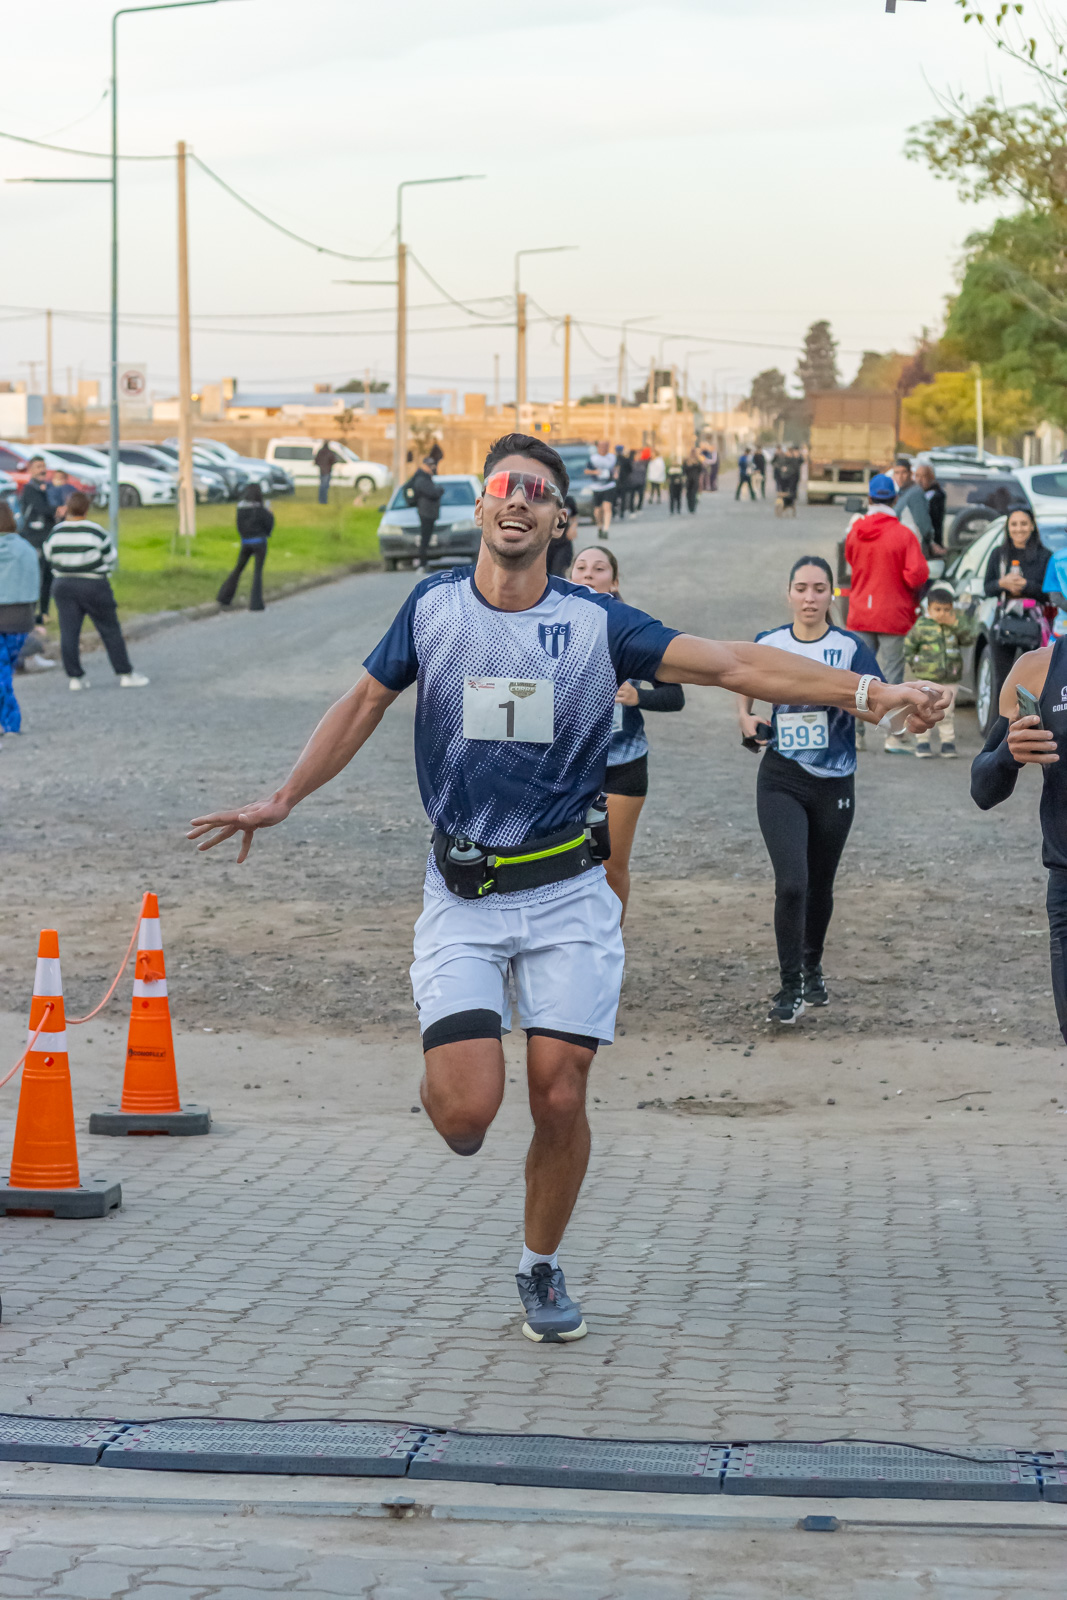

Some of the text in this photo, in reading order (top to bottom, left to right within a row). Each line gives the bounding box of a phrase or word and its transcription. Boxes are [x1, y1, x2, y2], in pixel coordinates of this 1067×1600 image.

[544, 626, 566, 635] SFC
[498, 700, 515, 738] 1
[780, 724, 826, 748] 593
